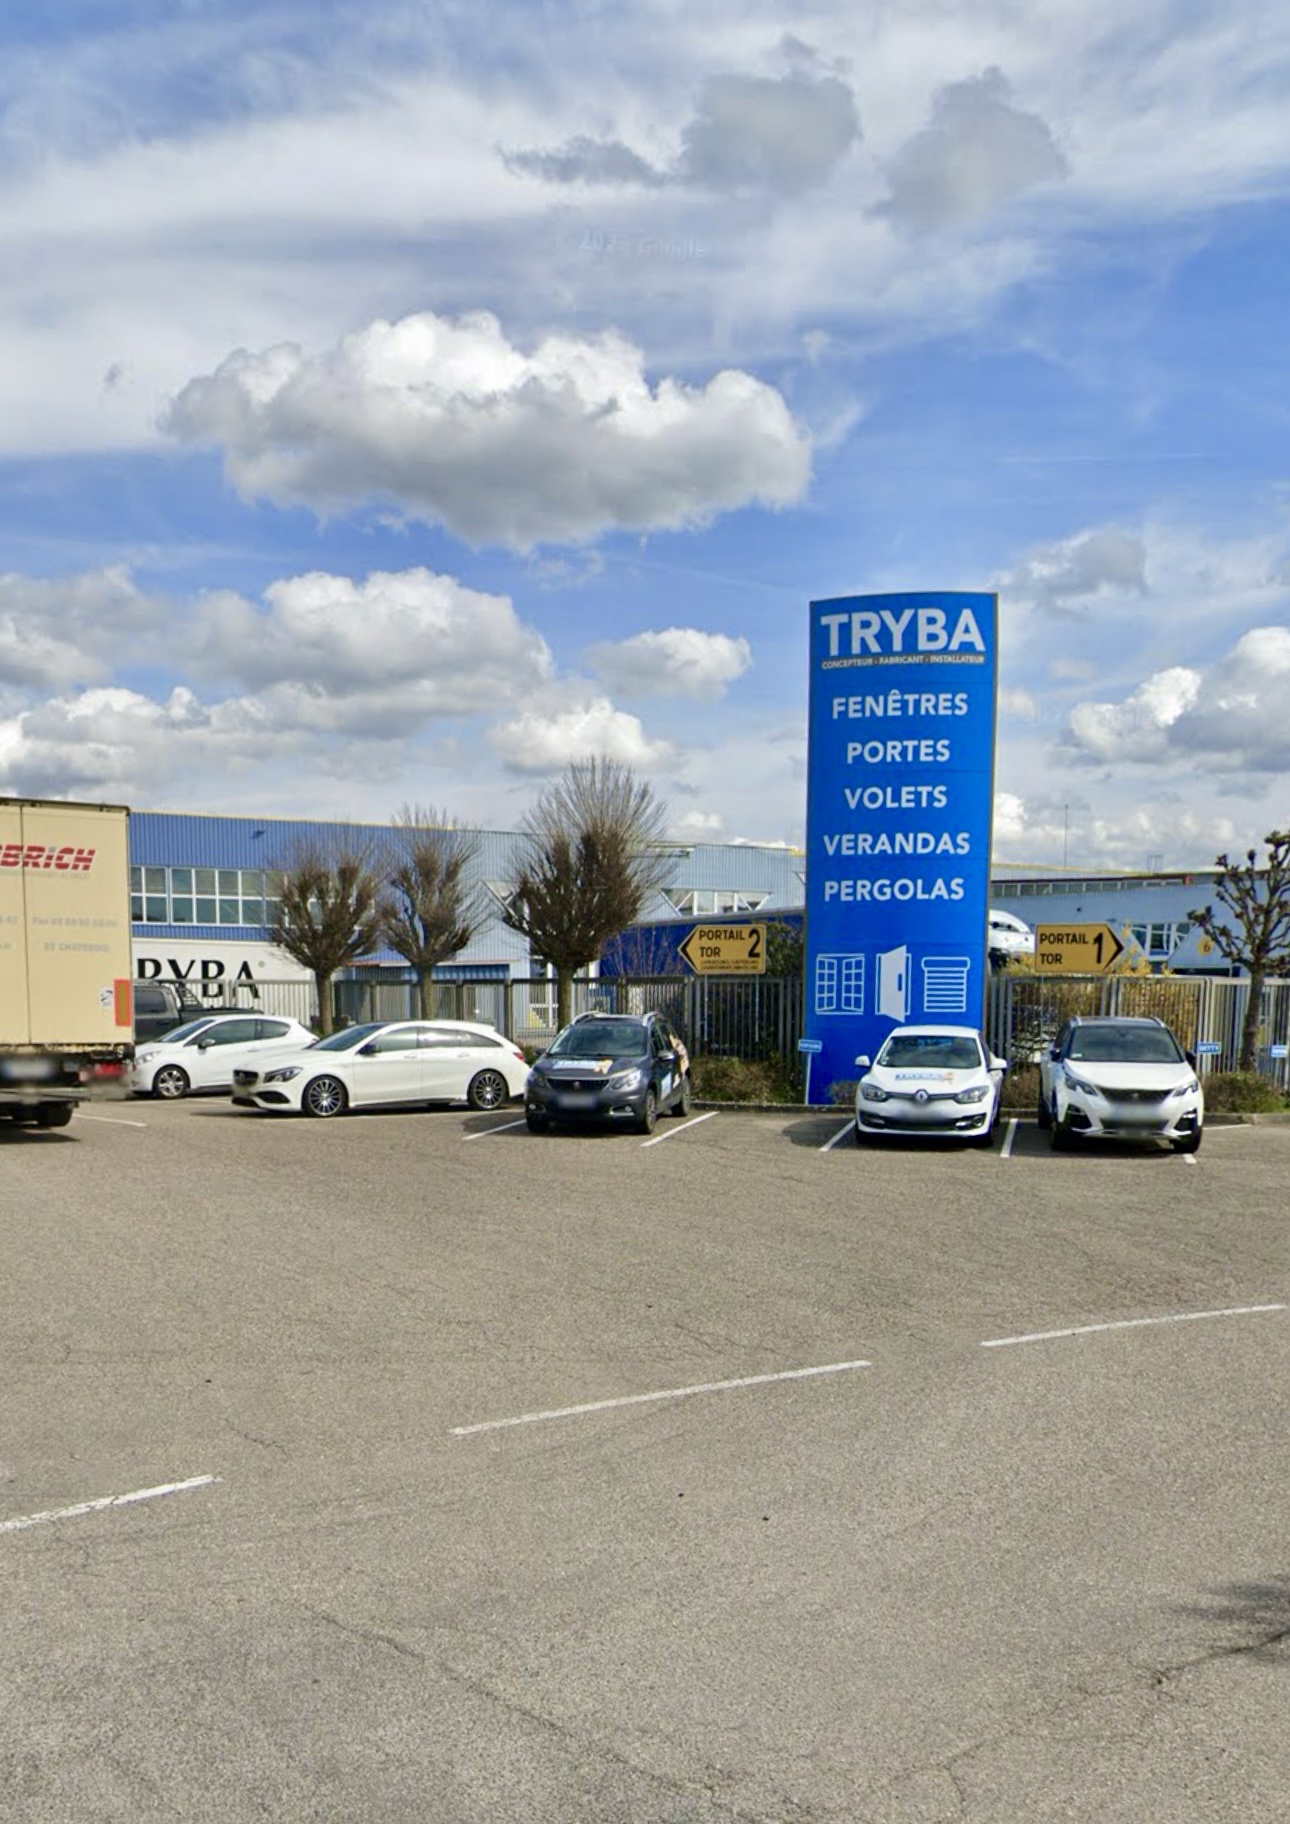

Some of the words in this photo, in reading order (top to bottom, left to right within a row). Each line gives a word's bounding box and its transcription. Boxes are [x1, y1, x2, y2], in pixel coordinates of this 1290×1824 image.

[820, 608, 986, 657] TRYBA
[879, 655, 924, 666] FABRICANT
[930, 654, 985, 664] INSTALLATEUR
[832, 689, 969, 719] FENÊTRES
[848, 740, 949, 763] PORTES
[845, 786, 947, 808] VOLETS
[824, 833, 969, 854] VERANDAS
[825, 878, 964, 901] PERGOLAS
[699, 929, 746, 941] PORTAIL
[747, 928, 761, 958] 2
[699, 946, 721, 958] TOR
[1039, 932, 1088, 945] PORTAIL
[1093, 932, 1104, 964] 1
[1039, 952, 1063, 965] TOR
[137, 958, 261, 999] RYBA
